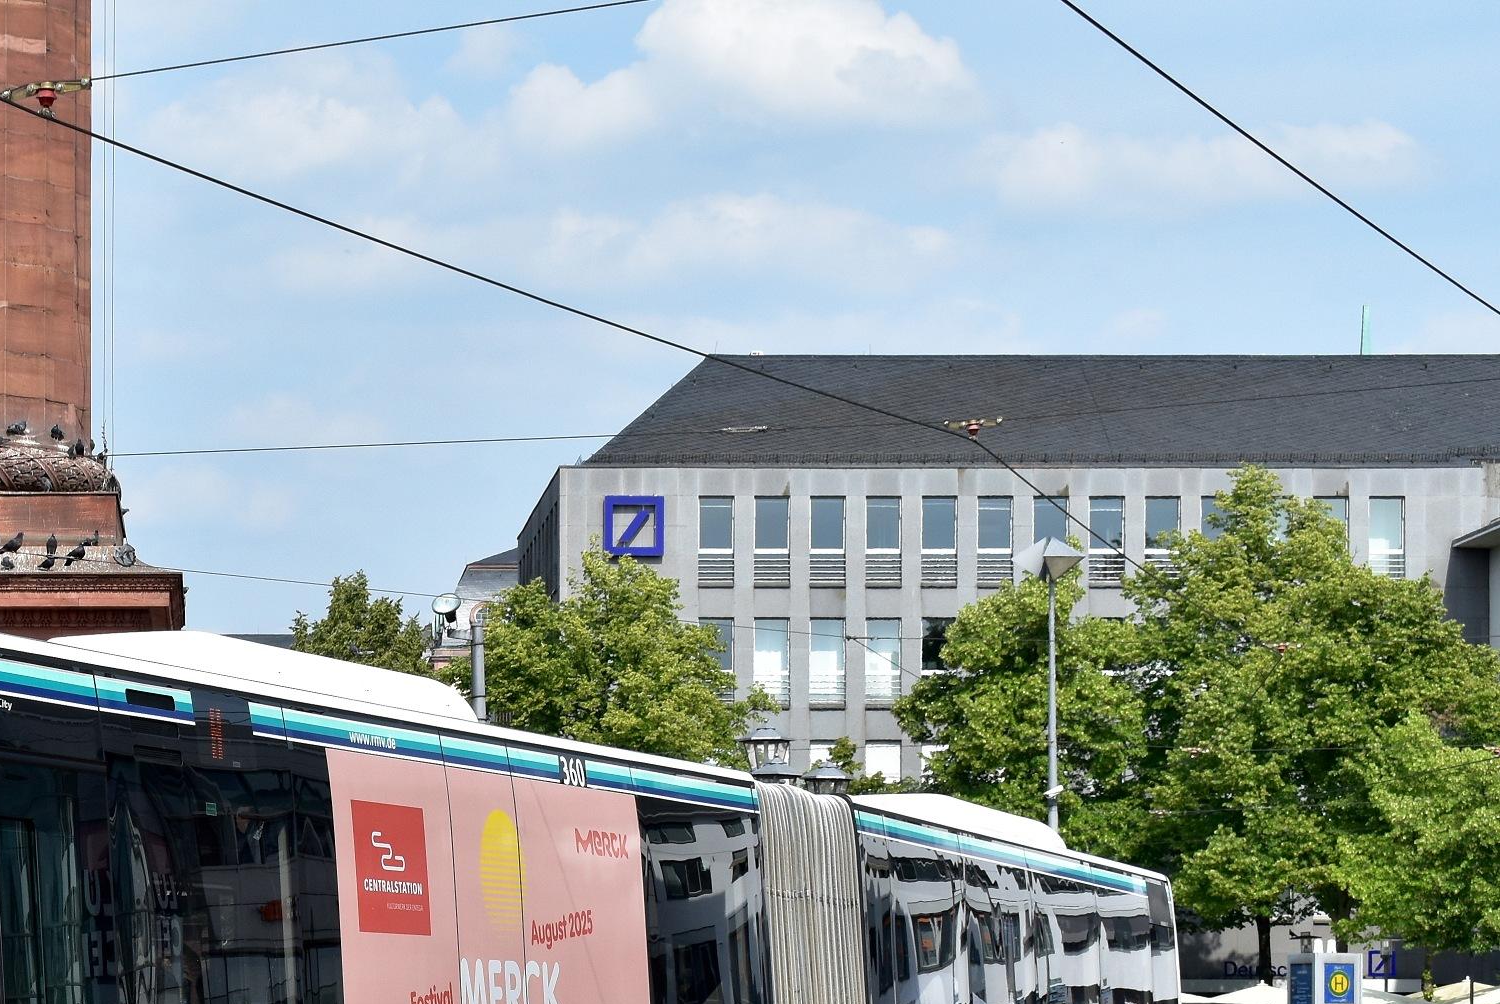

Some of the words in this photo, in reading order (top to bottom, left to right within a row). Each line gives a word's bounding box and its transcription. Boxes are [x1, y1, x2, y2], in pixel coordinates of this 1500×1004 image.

[349, 731, 397, 750] www.rmv.de
[560, 756, 586, 787] 360
[363, 878, 423, 895] CENTRALSTATION
[531, 914, 567, 950] August
[568, 910, 593, 938] 2025
